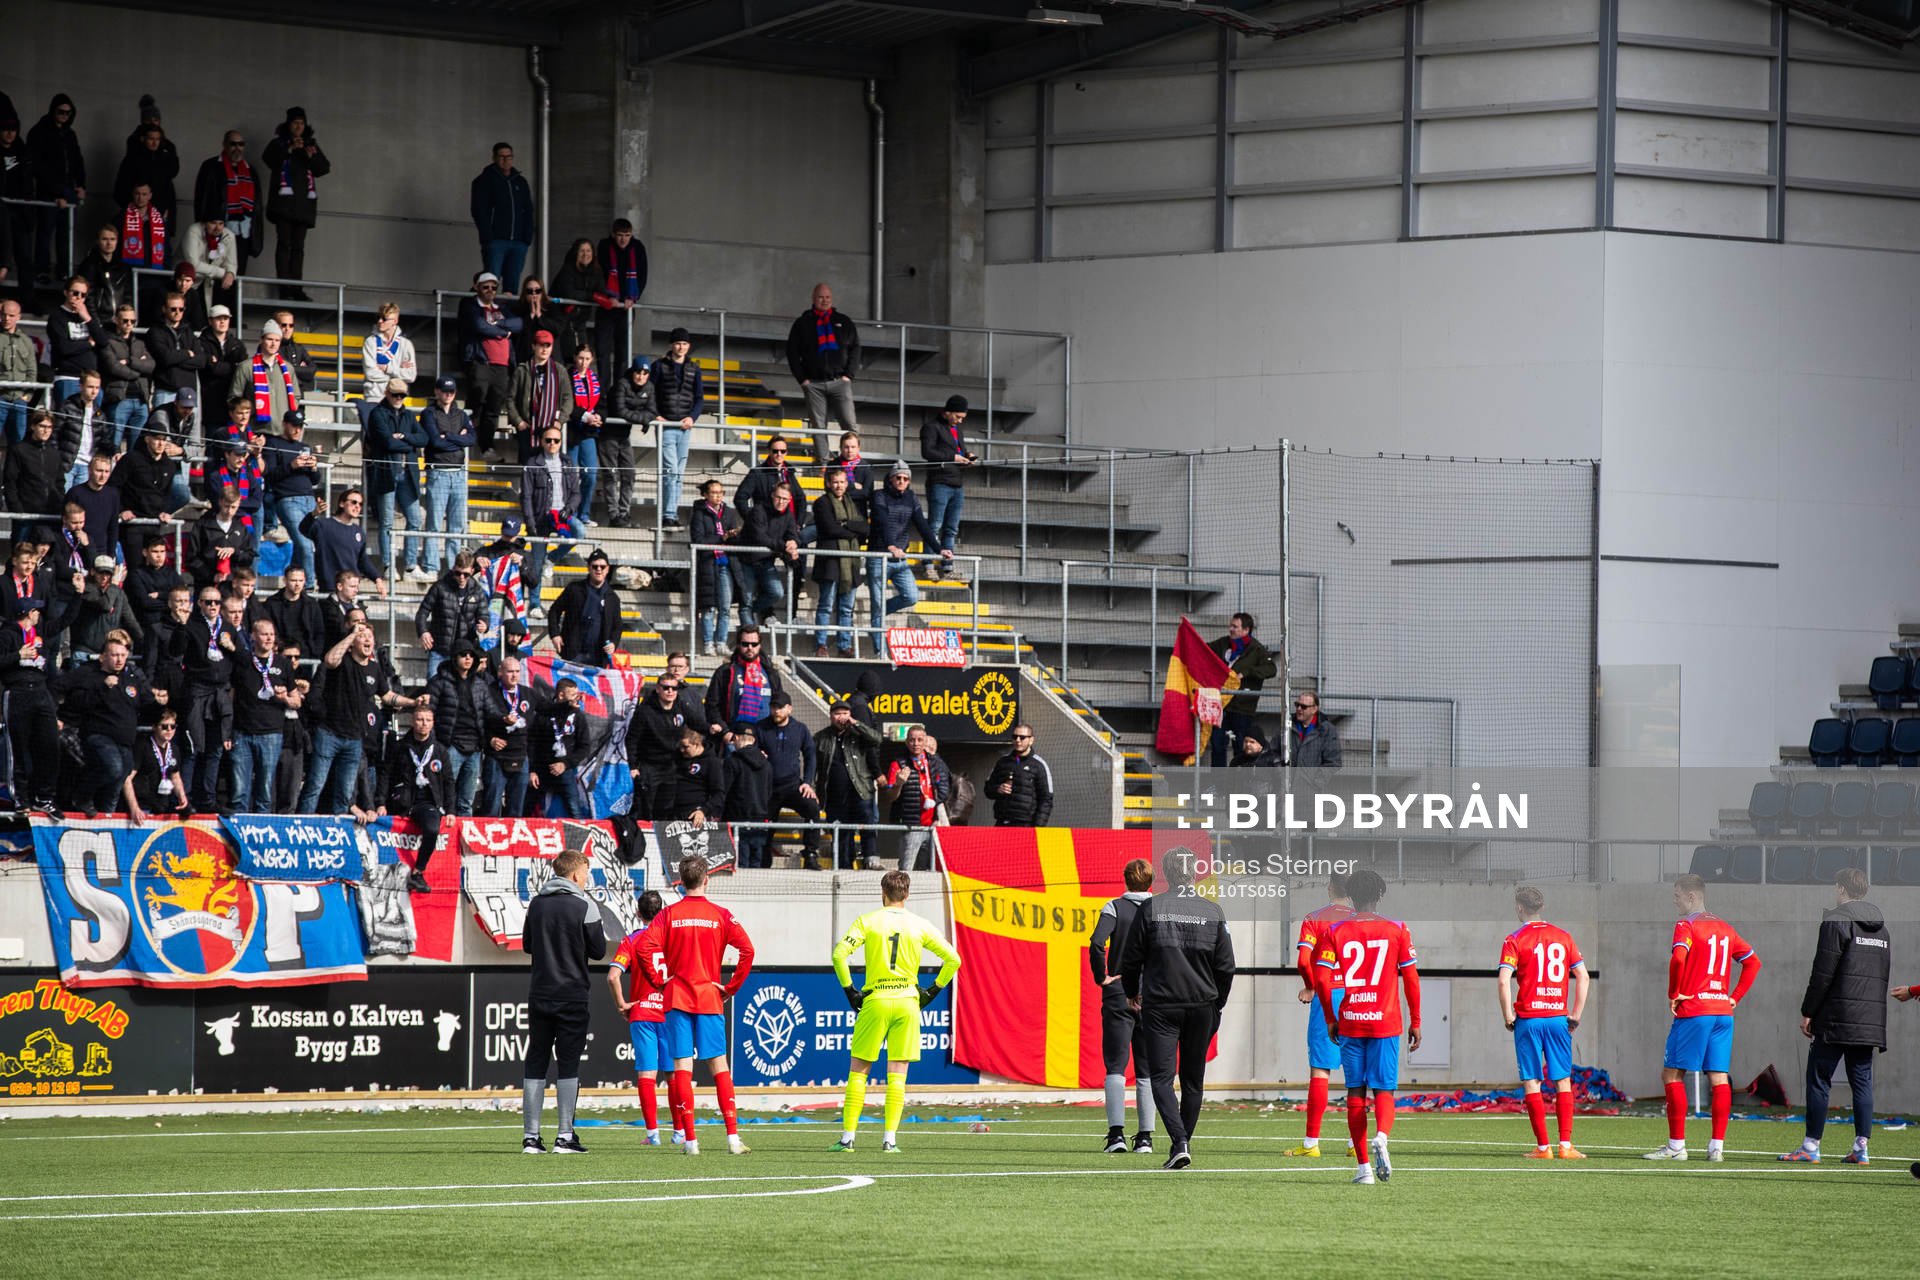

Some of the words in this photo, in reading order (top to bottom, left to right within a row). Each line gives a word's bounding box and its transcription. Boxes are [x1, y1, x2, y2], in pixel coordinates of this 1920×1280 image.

[889, 629, 945, 647] AWAYDAYS
[891, 647, 965, 665] HELSINGBORG
[973, 671, 998, 696] SVENSK
[919, 690, 970, 716] valet
[971, 700, 1017, 735] ENERGIOPTIMERING
[285, 819, 351, 846] KÄRLEK
[376, 830, 423, 851] CHOOS
[461, 820, 563, 854] ACAB
[57, 829, 131, 972] S
[672, 919, 712, 928] HELSINGBORGS
[713, 921, 719, 929] IF
[845, 935, 857, 947] XXL
[888, 932, 900, 971] 1
[1343, 939, 1389, 988] 27
[1533, 942, 1566, 983] 18
[1707, 934, 1730, 976] 11
[1536, 986, 1562, 997] NILSSON
[34, 979, 96, 1025] Thyr
[85, 1000, 130, 1039] AB
[251, 1005, 329, 1027] Kossan
[333, 1010, 345, 1027] o
[349, 1004, 424, 1027] Kalven
[485, 1003, 529, 1030] OPE
[743, 1003, 758, 1026] ETT
[753, 985, 786, 1007] BÄTTRE
[785, 992, 807, 1026] GÄVLE
[815, 1010, 841, 1028] ETT
[295, 1036, 348, 1062] Bygg
[350, 1035, 381, 1056] AB
[815, 1033, 845, 1050] DET
[920, 1033, 937, 1050] ED
[743, 1039, 753, 1059] DET
[751, 1055, 780, 1077] BÖRJAR
[781, 1054, 797, 1075] MED
[791, 1039, 806, 1055] DIG
[51, 1082, 65, 1095] 12
